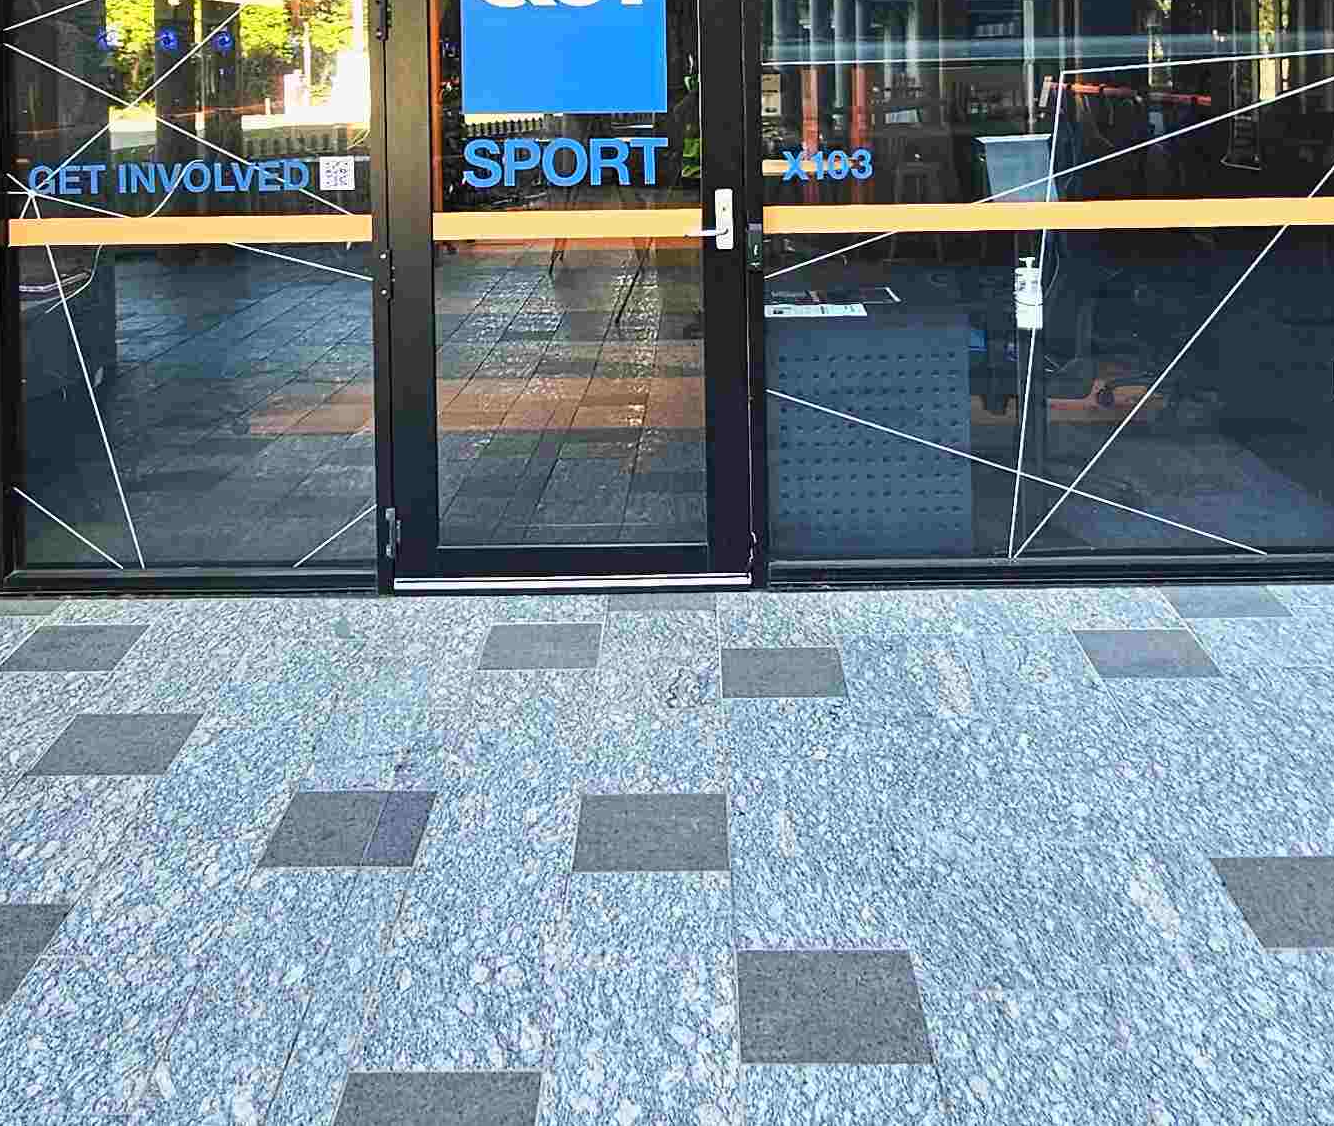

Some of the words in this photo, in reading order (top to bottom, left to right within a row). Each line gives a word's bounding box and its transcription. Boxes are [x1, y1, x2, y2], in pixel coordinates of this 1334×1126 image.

[27, 164, 106, 195] GET
[117, 158, 310, 195] INVOLVED
[463, 137, 668, 188] SPORT
[782, 149, 873, 182] X103
